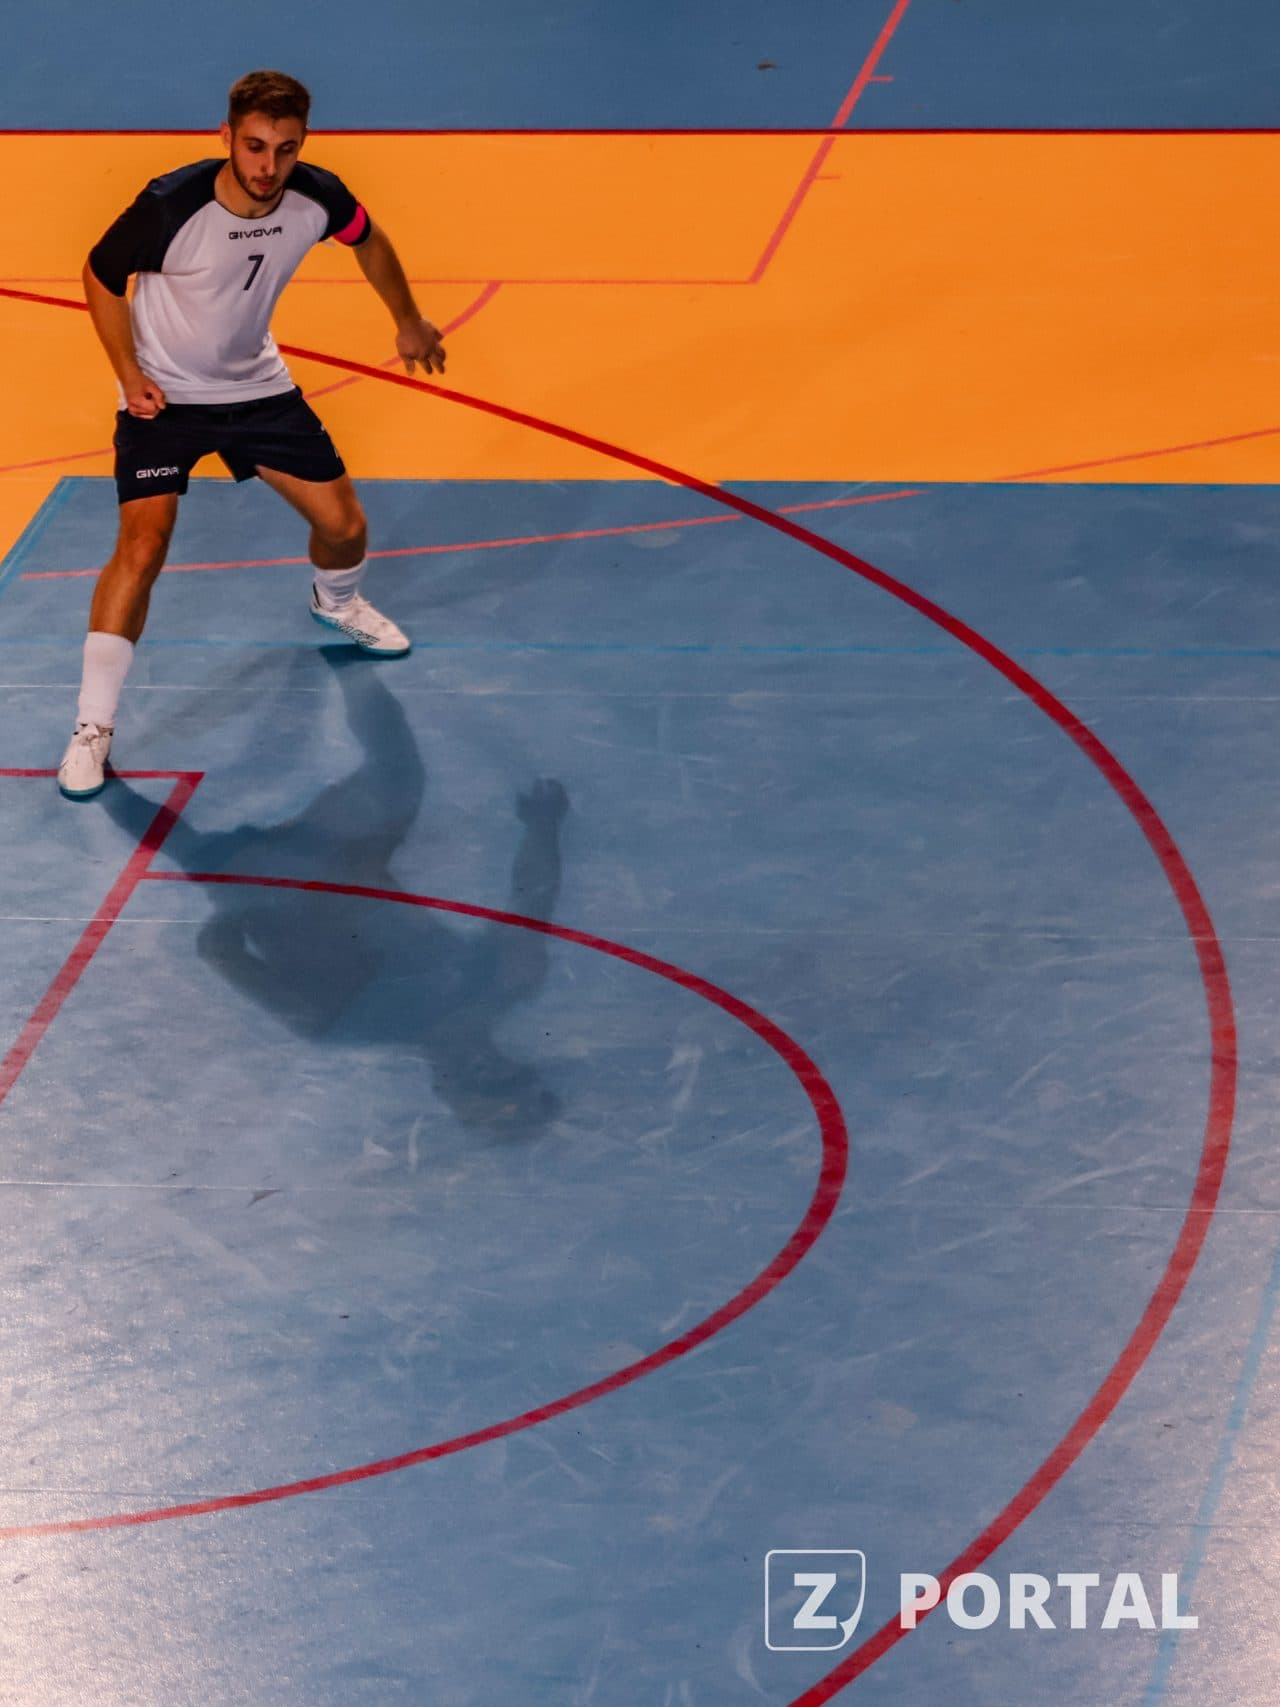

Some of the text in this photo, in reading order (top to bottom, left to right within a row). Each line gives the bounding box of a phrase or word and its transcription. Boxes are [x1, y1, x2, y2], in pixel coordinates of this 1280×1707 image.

[228, 225, 282, 240] GIVOVA
[243, 254, 264, 290] 7
[136, 466, 180, 479] GIVOVA
